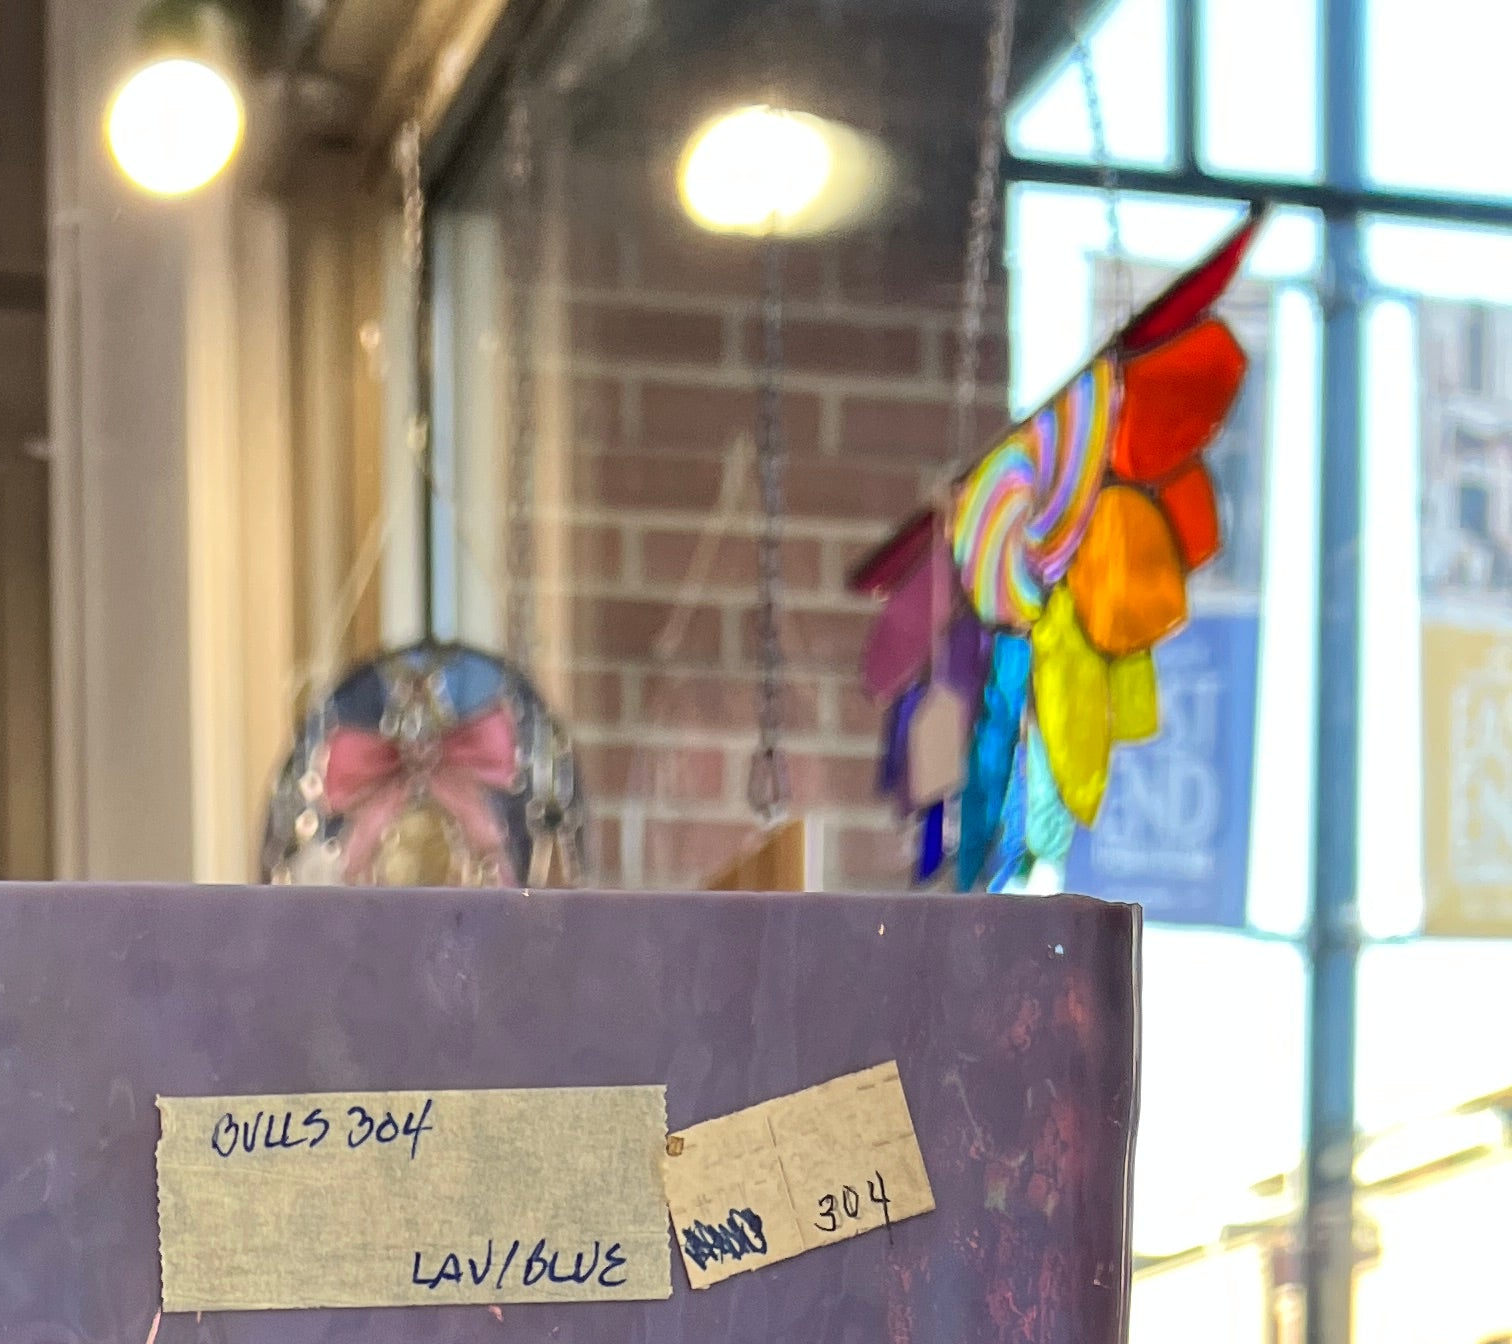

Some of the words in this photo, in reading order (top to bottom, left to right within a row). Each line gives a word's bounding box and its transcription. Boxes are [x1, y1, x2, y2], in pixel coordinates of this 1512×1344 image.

[211, 1110, 330, 1157] BULLS
[347, 1098, 433, 1160] 304
[813, 1169, 894, 1246] 304
[411, 1237, 628, 1290] LAV/BLUE
